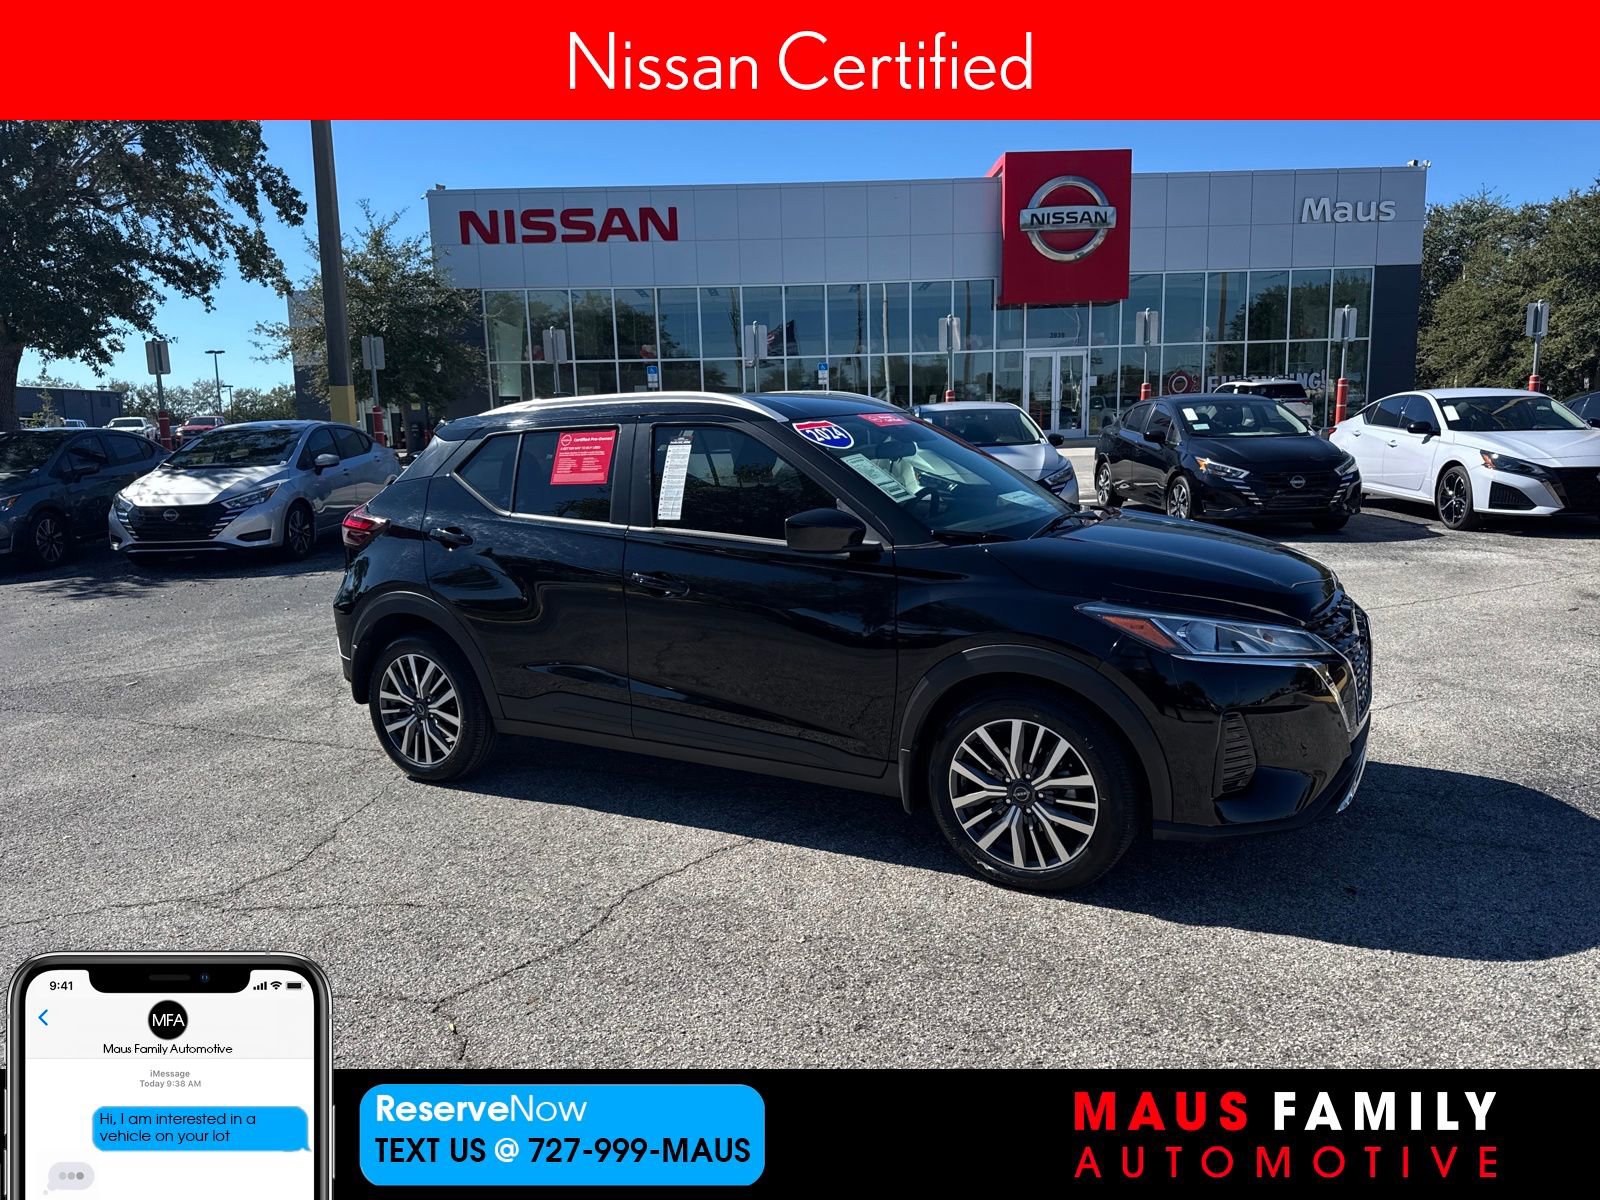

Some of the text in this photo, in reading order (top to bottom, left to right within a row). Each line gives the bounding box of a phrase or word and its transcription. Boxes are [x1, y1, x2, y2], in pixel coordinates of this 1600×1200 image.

[1030, 210, 1108, 225] NISSAN
[1301, 197, 1397, 223] Maus
[459, 207, 679, 245] NISSAN
[806, 427, 848, 441] 2024
